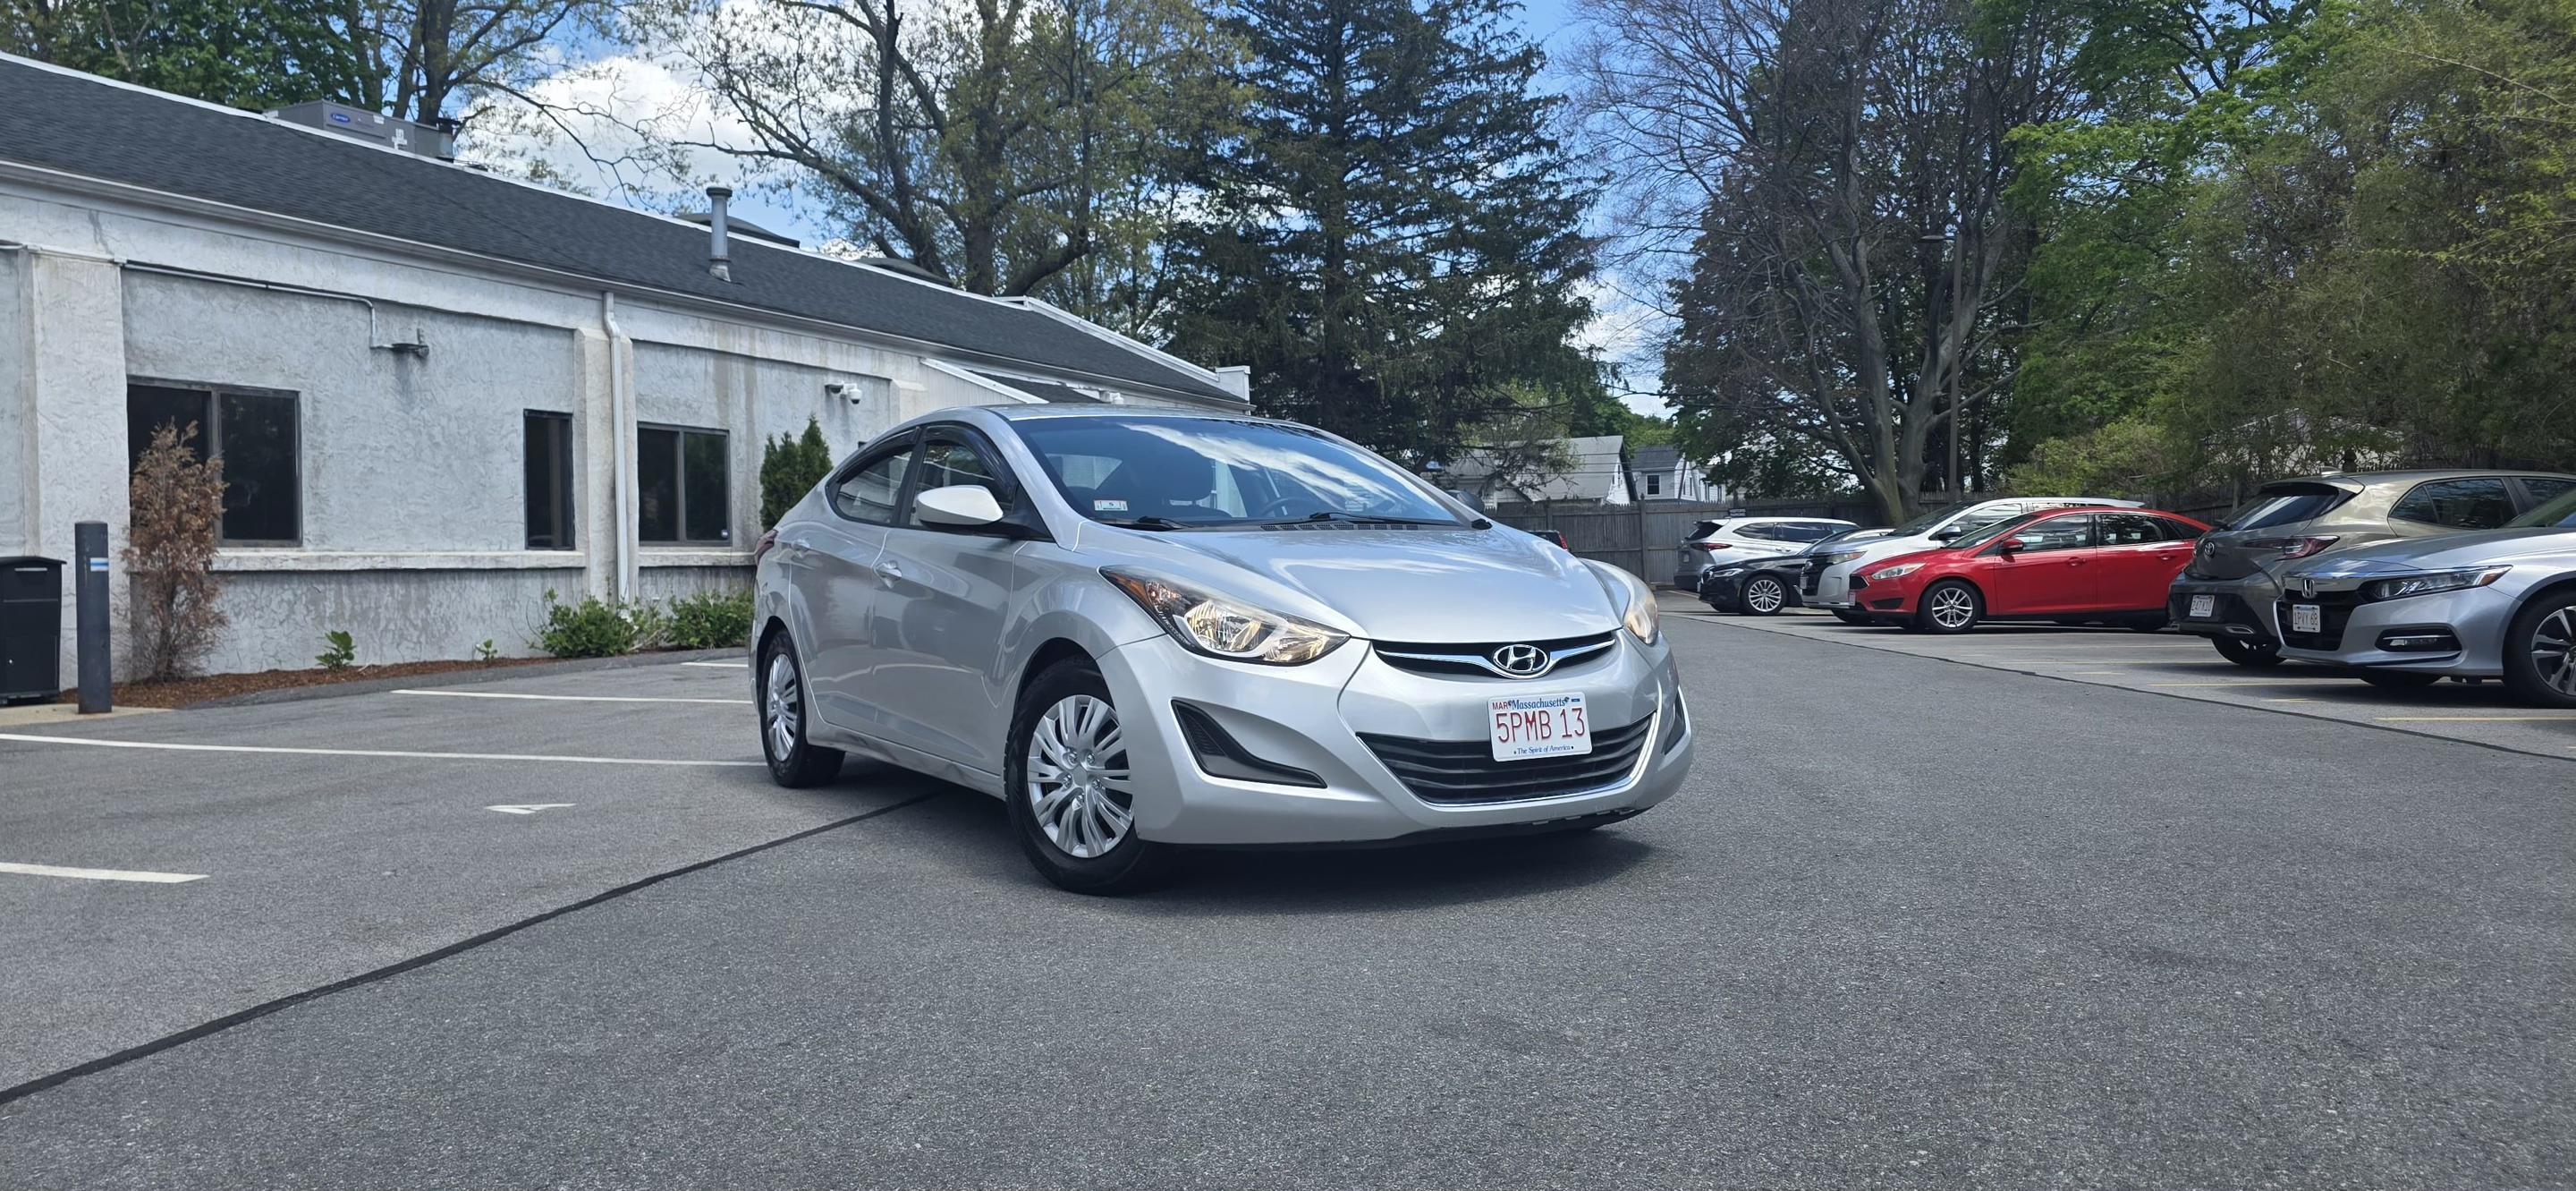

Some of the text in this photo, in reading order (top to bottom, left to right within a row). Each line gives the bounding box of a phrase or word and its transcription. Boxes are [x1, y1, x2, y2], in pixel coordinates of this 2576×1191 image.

[1492, 702, 1508, 710] MAR
[1512, 698, 1565, 710] Massachusetts
[1496, 707, 1585, 743] 5PMB 13
[1529, 746, 1542, 754] Spirit
